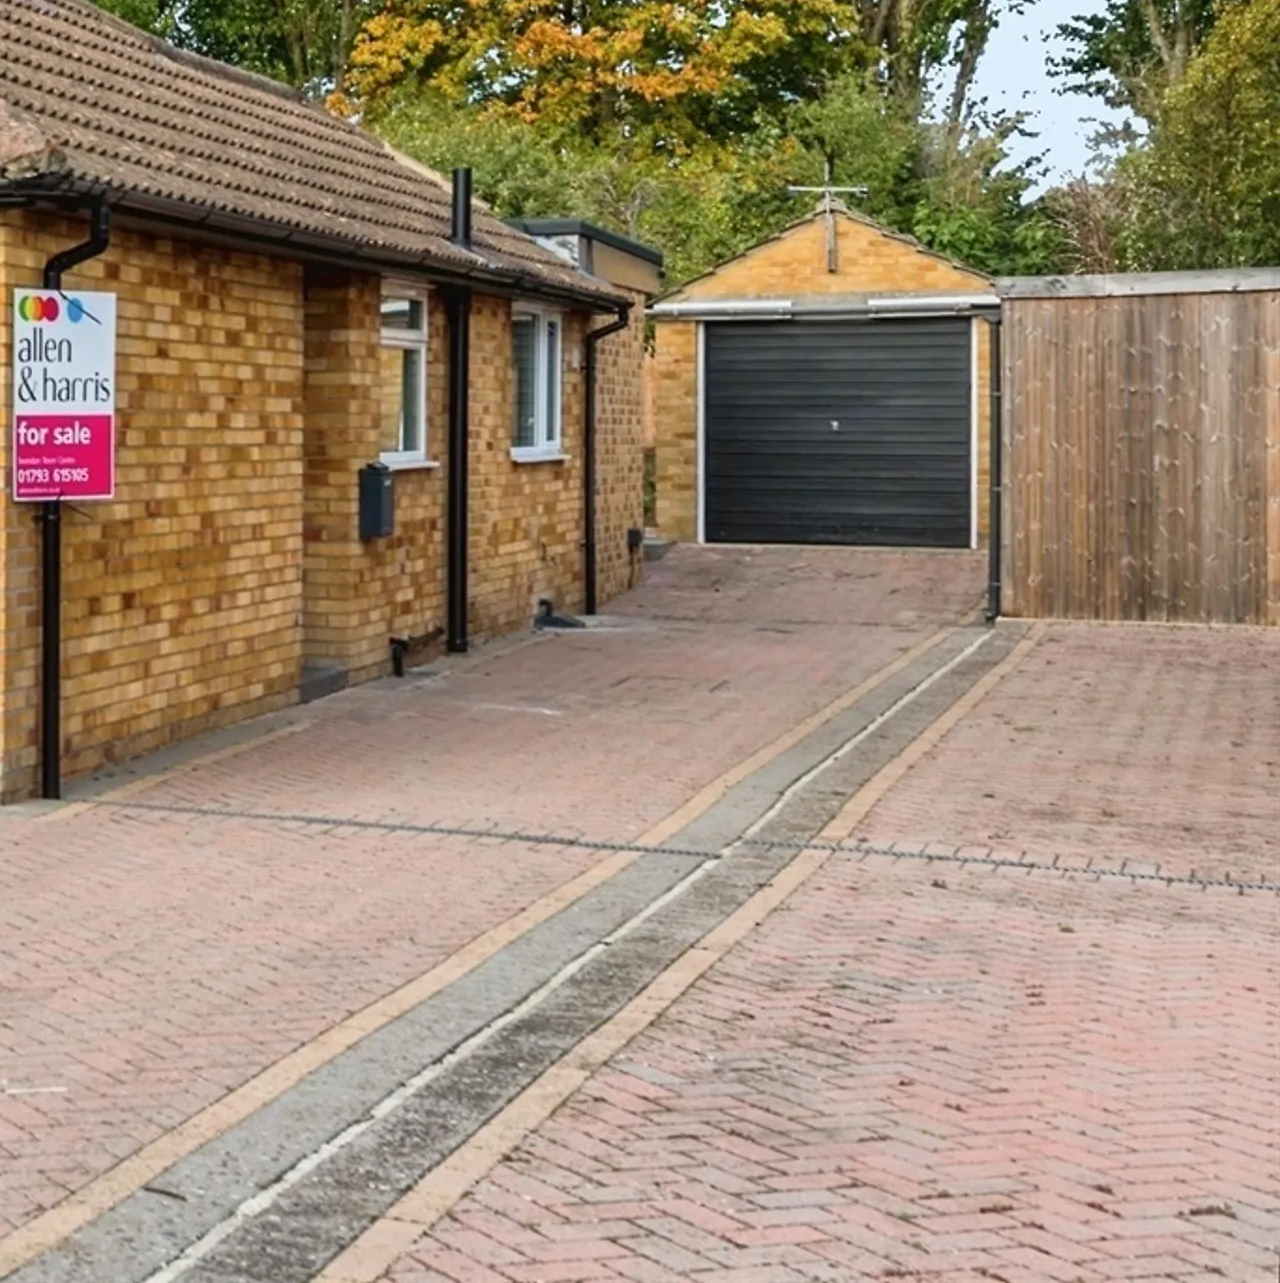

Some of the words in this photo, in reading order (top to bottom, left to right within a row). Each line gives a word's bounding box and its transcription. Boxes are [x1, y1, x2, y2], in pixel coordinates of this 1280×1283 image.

[18, 327, 72, 363] allen
[18, 365, 38, 403] &
[43, 367, 111, 403] harris
[17, 421, 49, 446] for
[53, 421, 92, 446] sale
[18, 468, 50, 484] 01793
